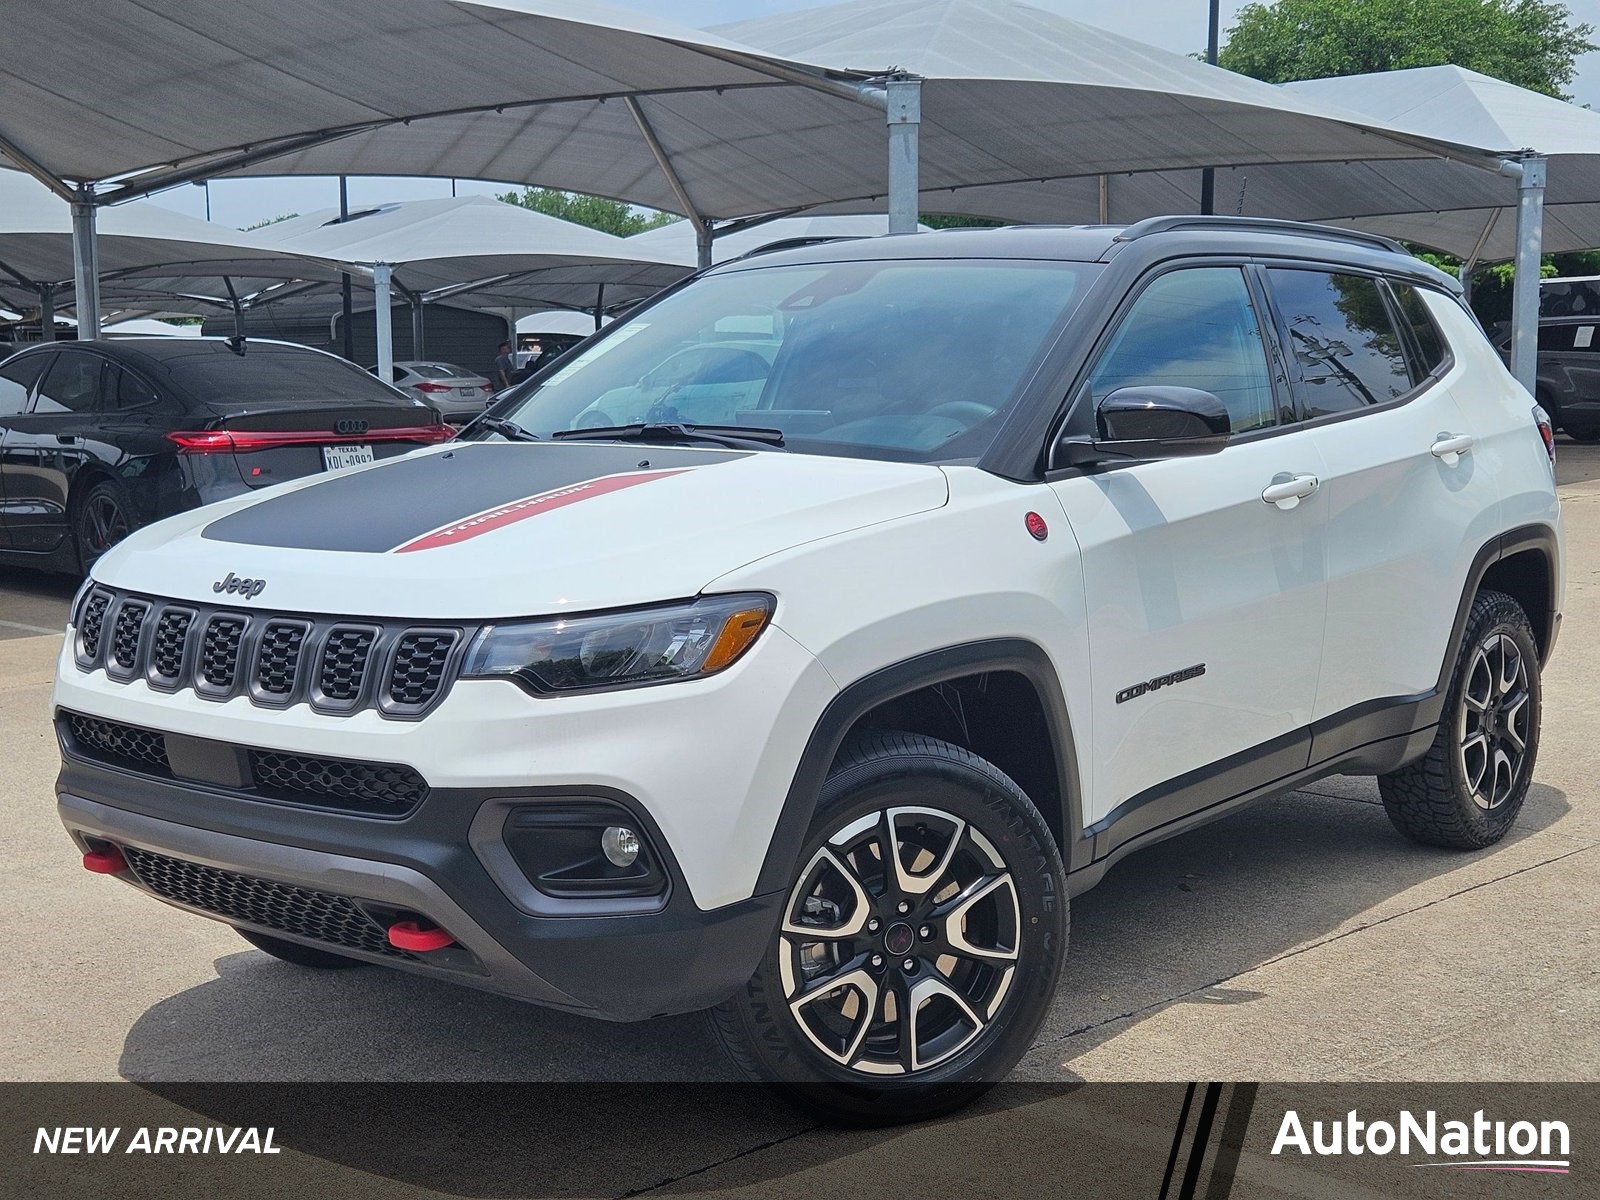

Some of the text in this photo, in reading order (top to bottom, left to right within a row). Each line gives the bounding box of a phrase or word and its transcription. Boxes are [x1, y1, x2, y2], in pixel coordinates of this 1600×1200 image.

[434, 483, 596, 538] TRAILHAWK
[212, 571, 267, 600] Jeep
[1115, 662, 1206, 704] COMPASS
